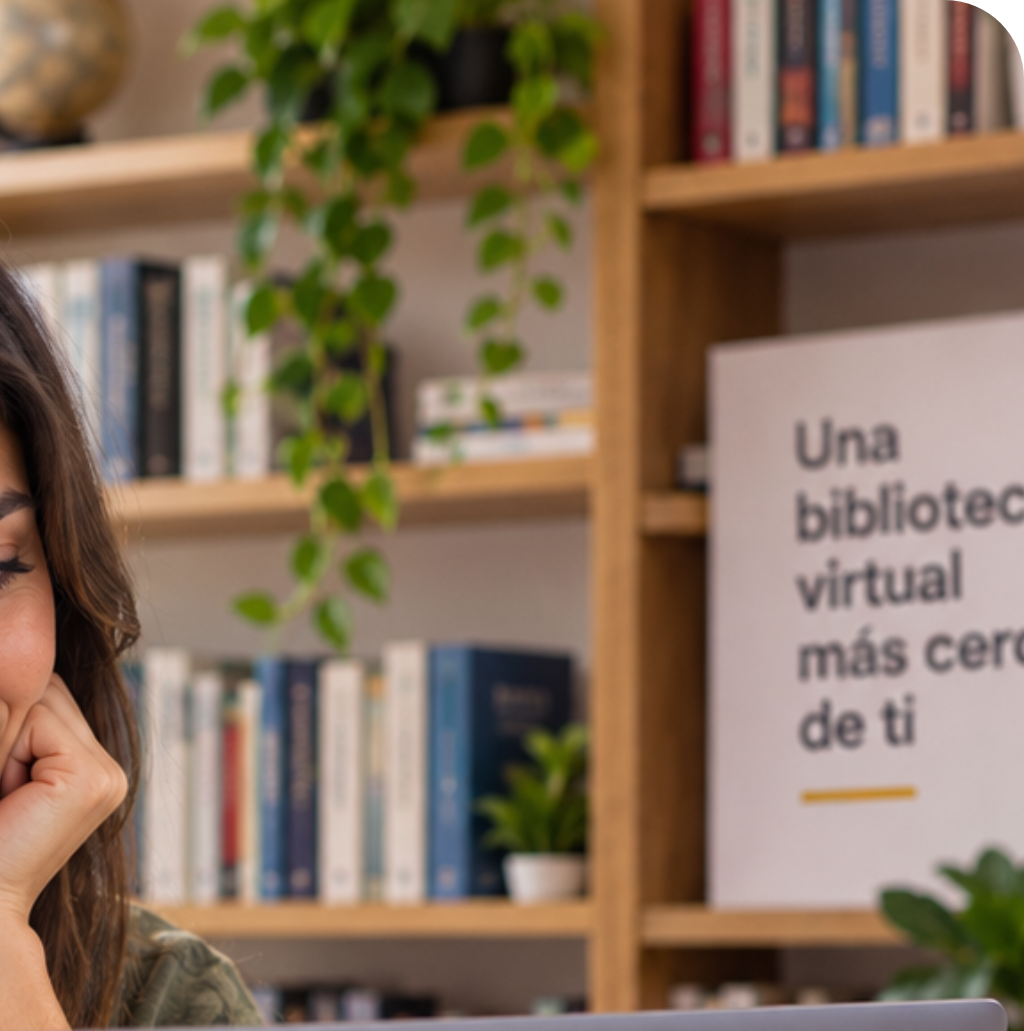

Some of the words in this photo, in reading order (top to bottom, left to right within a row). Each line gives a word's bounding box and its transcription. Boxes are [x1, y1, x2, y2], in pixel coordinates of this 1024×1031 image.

[794, 418, 900, 471] Una
[796, 549, 963, 612] virtual
[798, 625, 908, 681] más
[798, 697, 866, 752] de
[880, 693, 915, 747] ti
